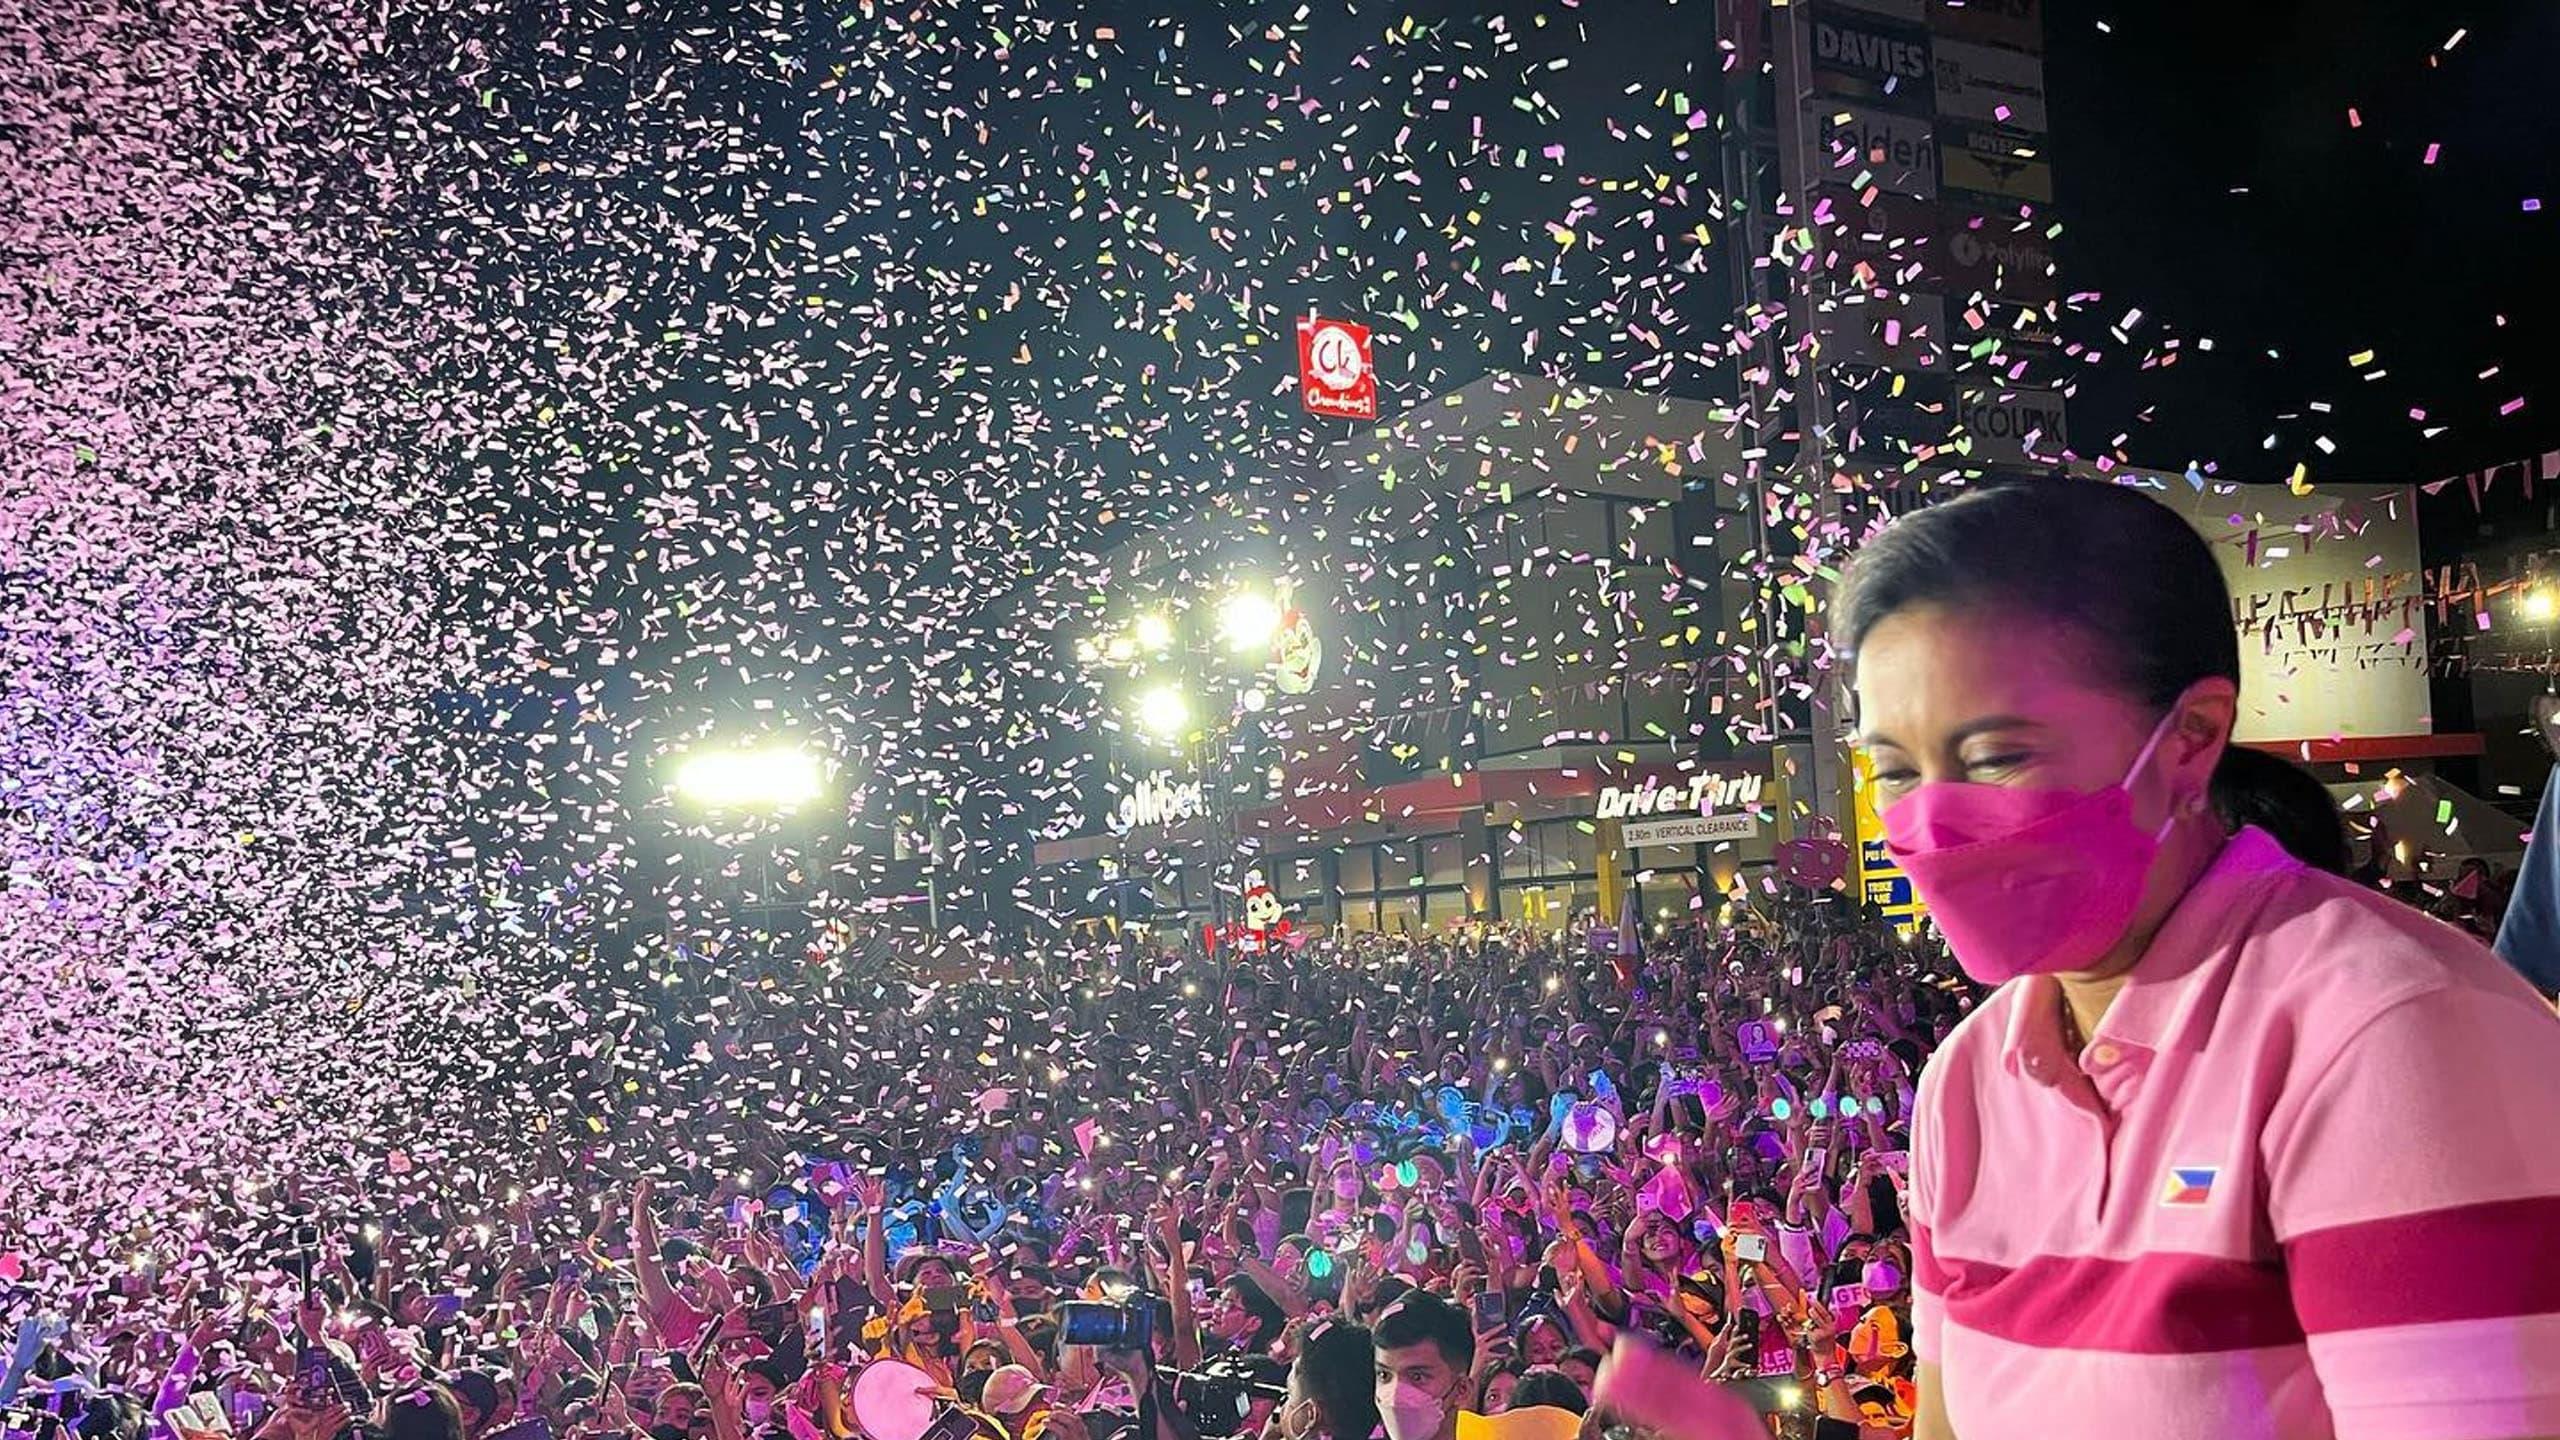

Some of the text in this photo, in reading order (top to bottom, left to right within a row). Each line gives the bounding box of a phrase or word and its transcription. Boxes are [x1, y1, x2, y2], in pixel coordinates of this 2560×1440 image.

[1817, 24, 1926, 78] DAVIES
[1820, 114, 1932, 171] olden
[1597, 774, 1761, 818] Drive-Thru
[1655, 823, 1695, 839] VERTICAL
[1697, 819, 1749, 834] CLEARANCE
